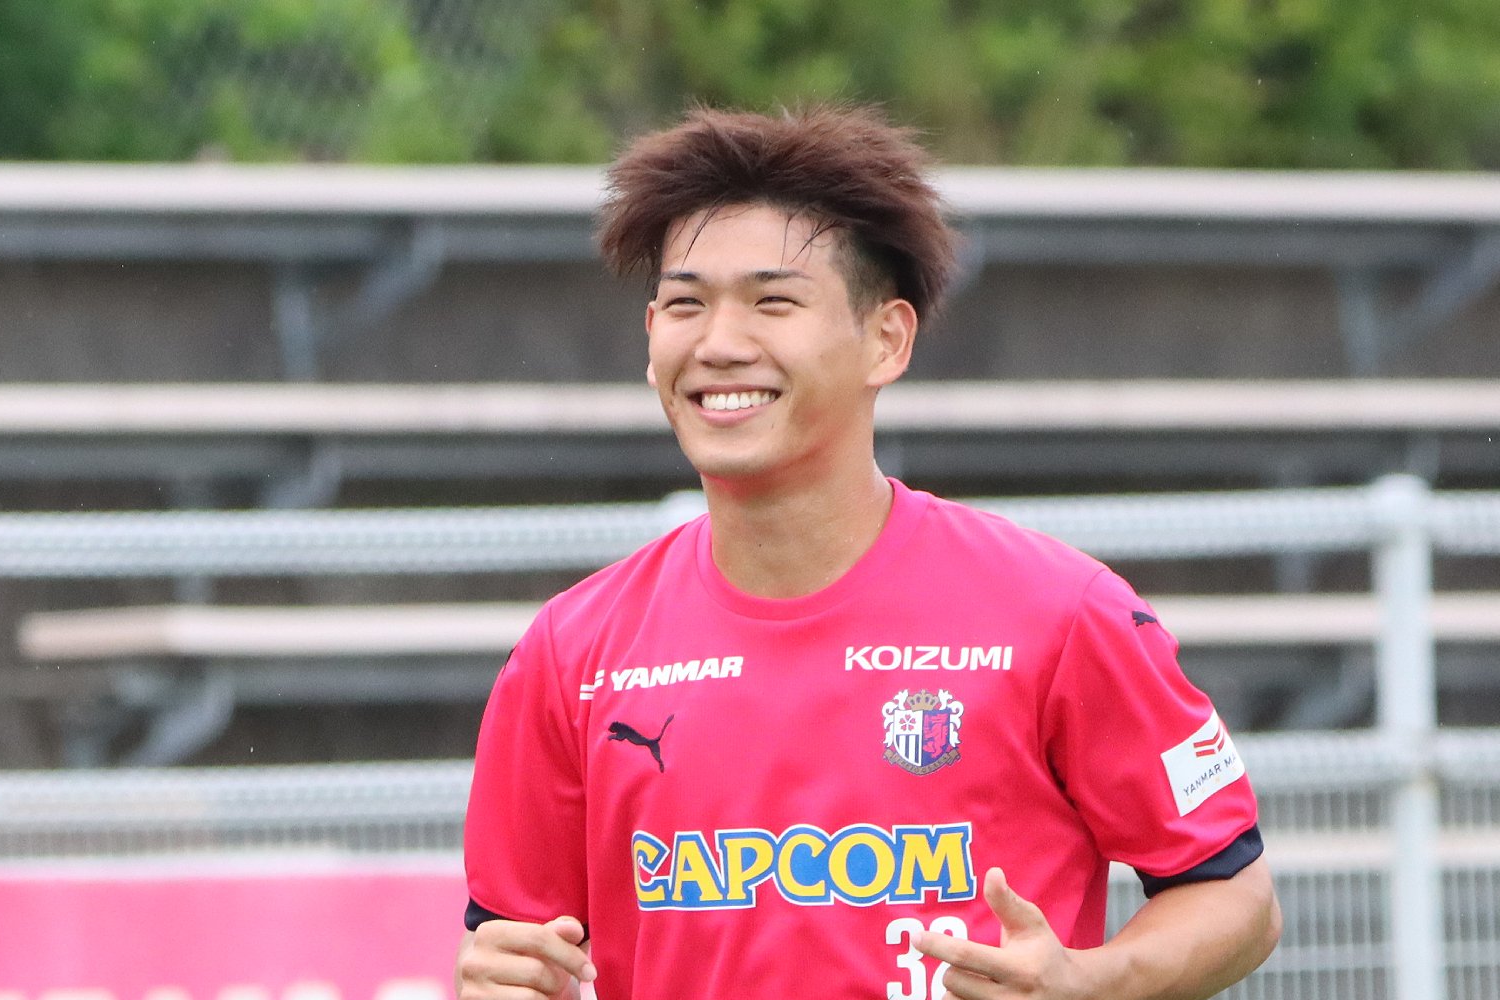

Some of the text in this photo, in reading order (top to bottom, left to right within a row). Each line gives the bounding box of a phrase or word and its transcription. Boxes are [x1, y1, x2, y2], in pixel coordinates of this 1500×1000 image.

[610, 655, 743, 692] YANMAR
[845, 646, 1013, 671] KOIZUMI
[1183, 763, 1222, 797] YANMAR
[631, 822, 976, 909] CAPCOM
